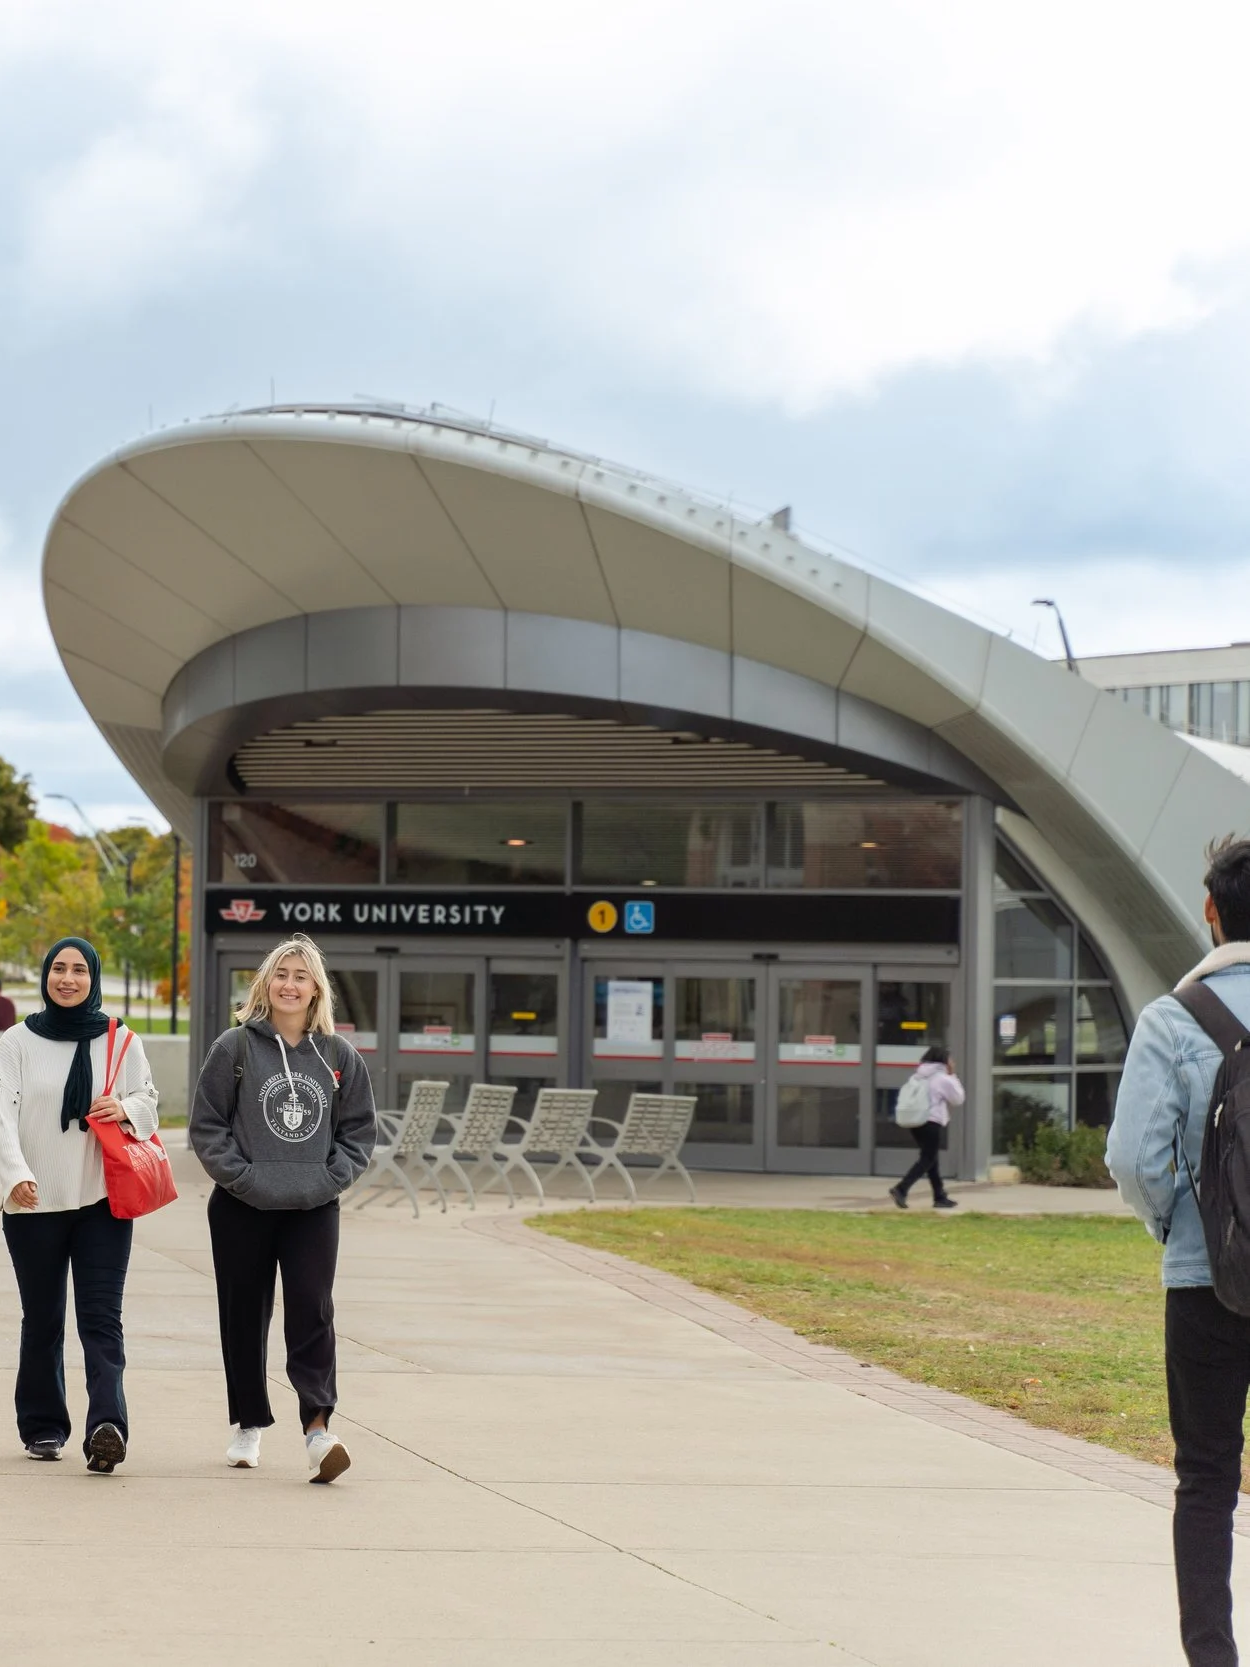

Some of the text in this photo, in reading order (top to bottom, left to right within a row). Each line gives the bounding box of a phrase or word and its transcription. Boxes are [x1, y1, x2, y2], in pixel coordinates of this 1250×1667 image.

[233, 853, 257, 868] 120
[279, 902, 505, 925] YORK UNIVERSITY
[297, 1082, 318, 1103] CANADA
[304, 1074, 328, 1108] UNIVERSITY
[270, 1119, 316, 1138] TENTANDA VIA
